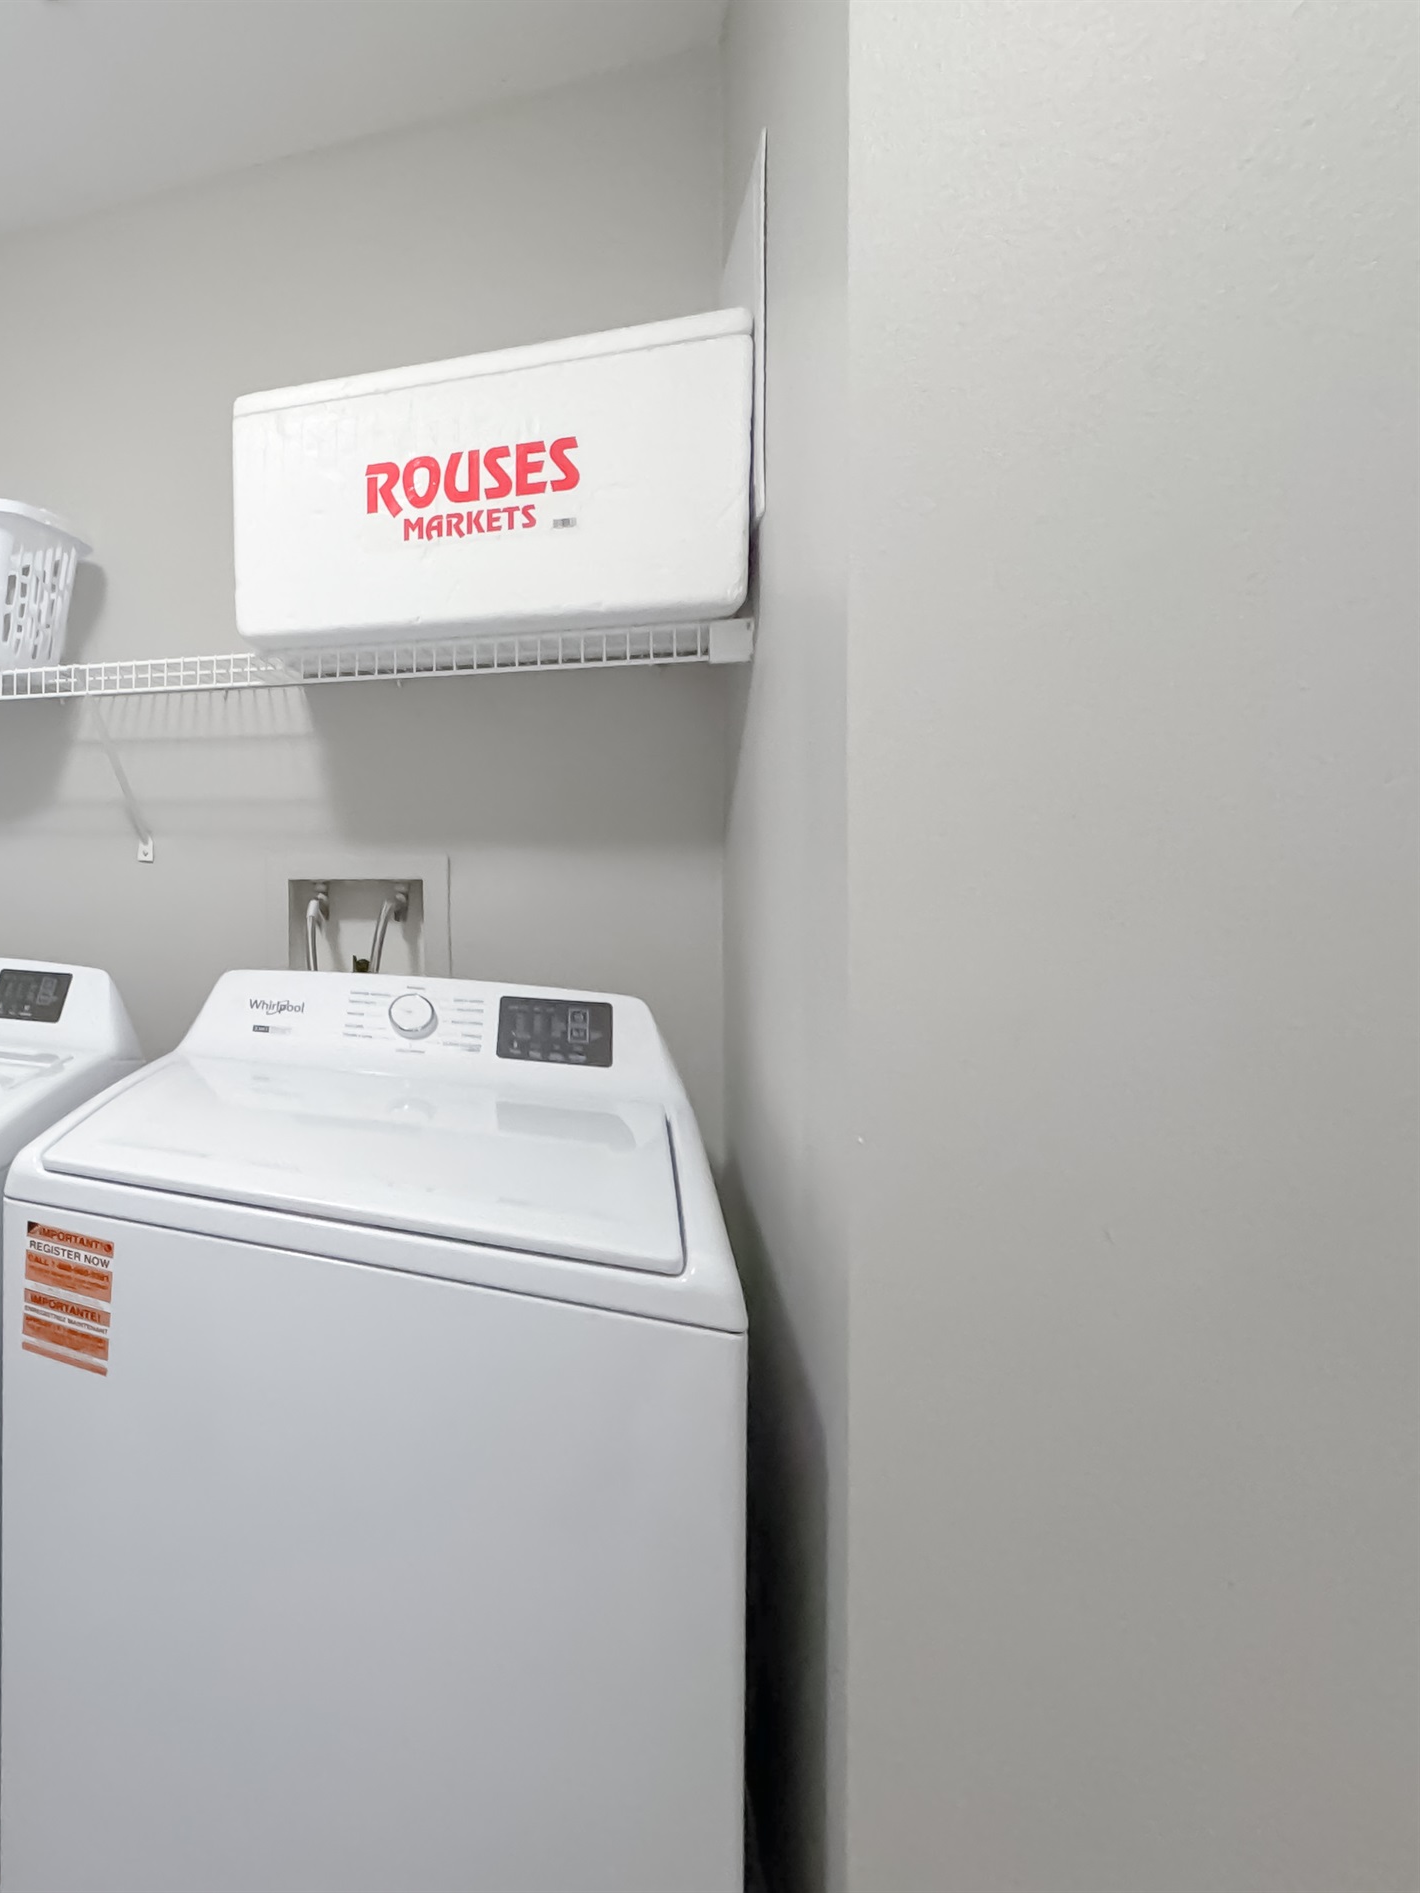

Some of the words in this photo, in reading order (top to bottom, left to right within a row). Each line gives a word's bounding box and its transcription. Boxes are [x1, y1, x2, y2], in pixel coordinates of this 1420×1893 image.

[365, 436, 581, 518] ROUSES
[403, 504, 537, 541] MARKETS
[249, 998, 305, 1015] Whirlpool
[29, 1240, 81, 1262] REGISTER
[84, 1254, 110, 1268] NOW
